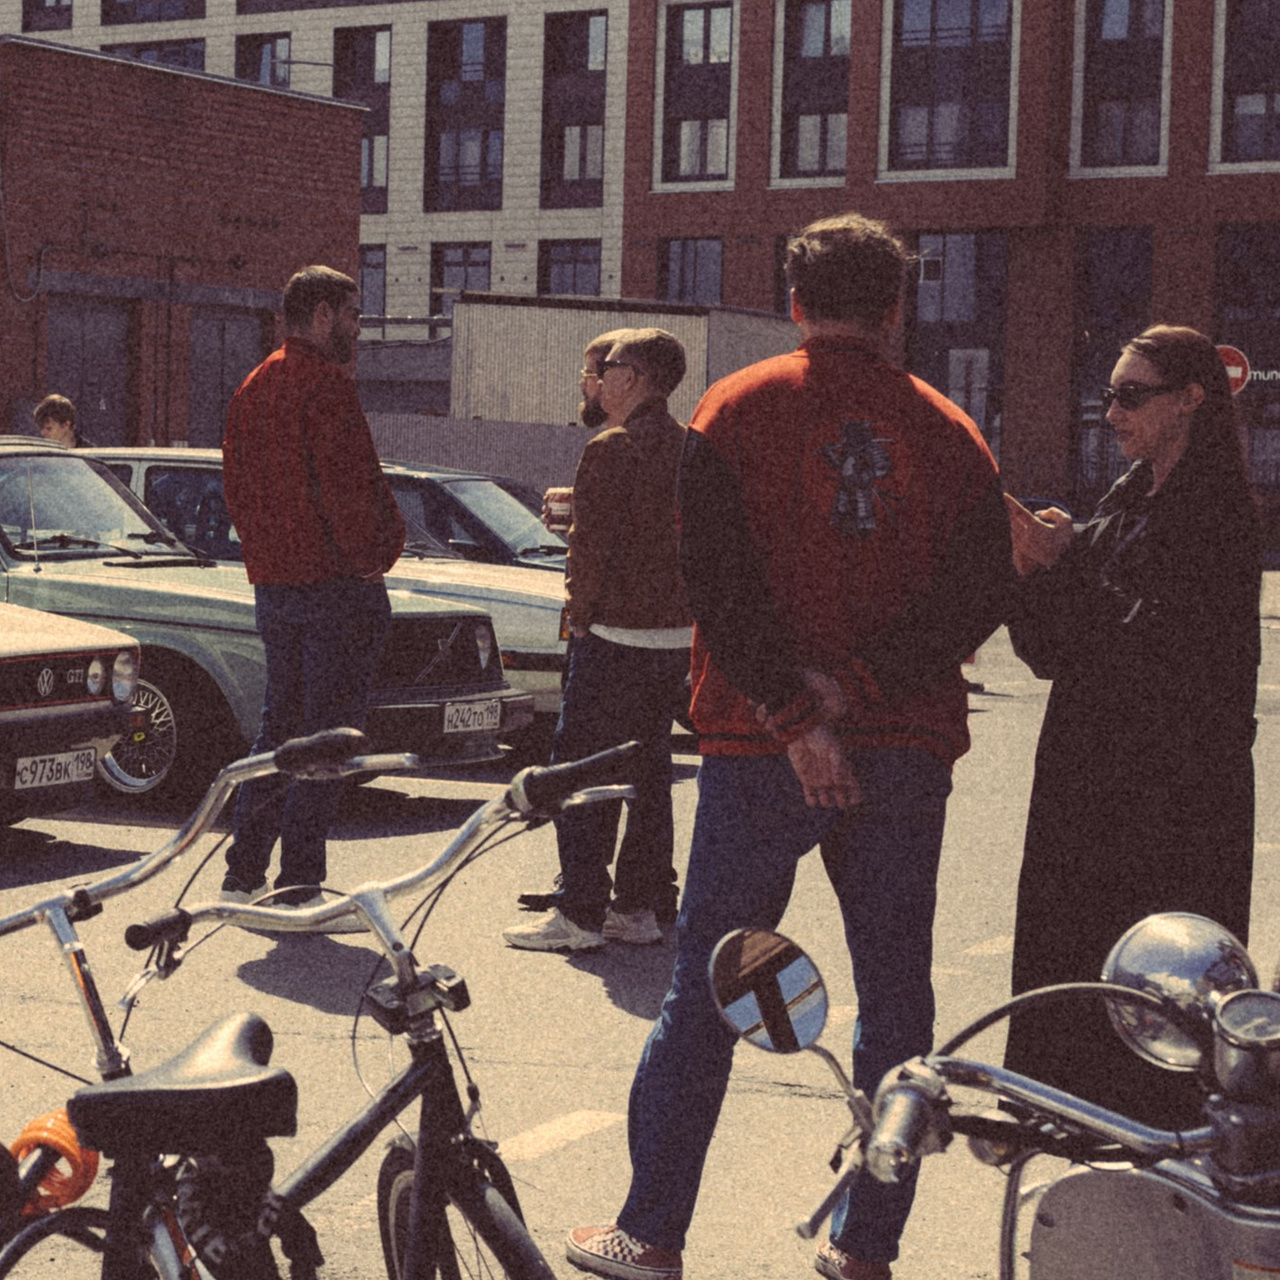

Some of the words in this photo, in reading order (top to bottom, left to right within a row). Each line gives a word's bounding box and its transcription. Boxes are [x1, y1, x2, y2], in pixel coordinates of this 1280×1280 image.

[1250, 370, 1280, 381] mun
[66, 668, 84, 684] GTI
[19, 757, 71, 785] С973ВК
[73, 751, 93, 771] 198
